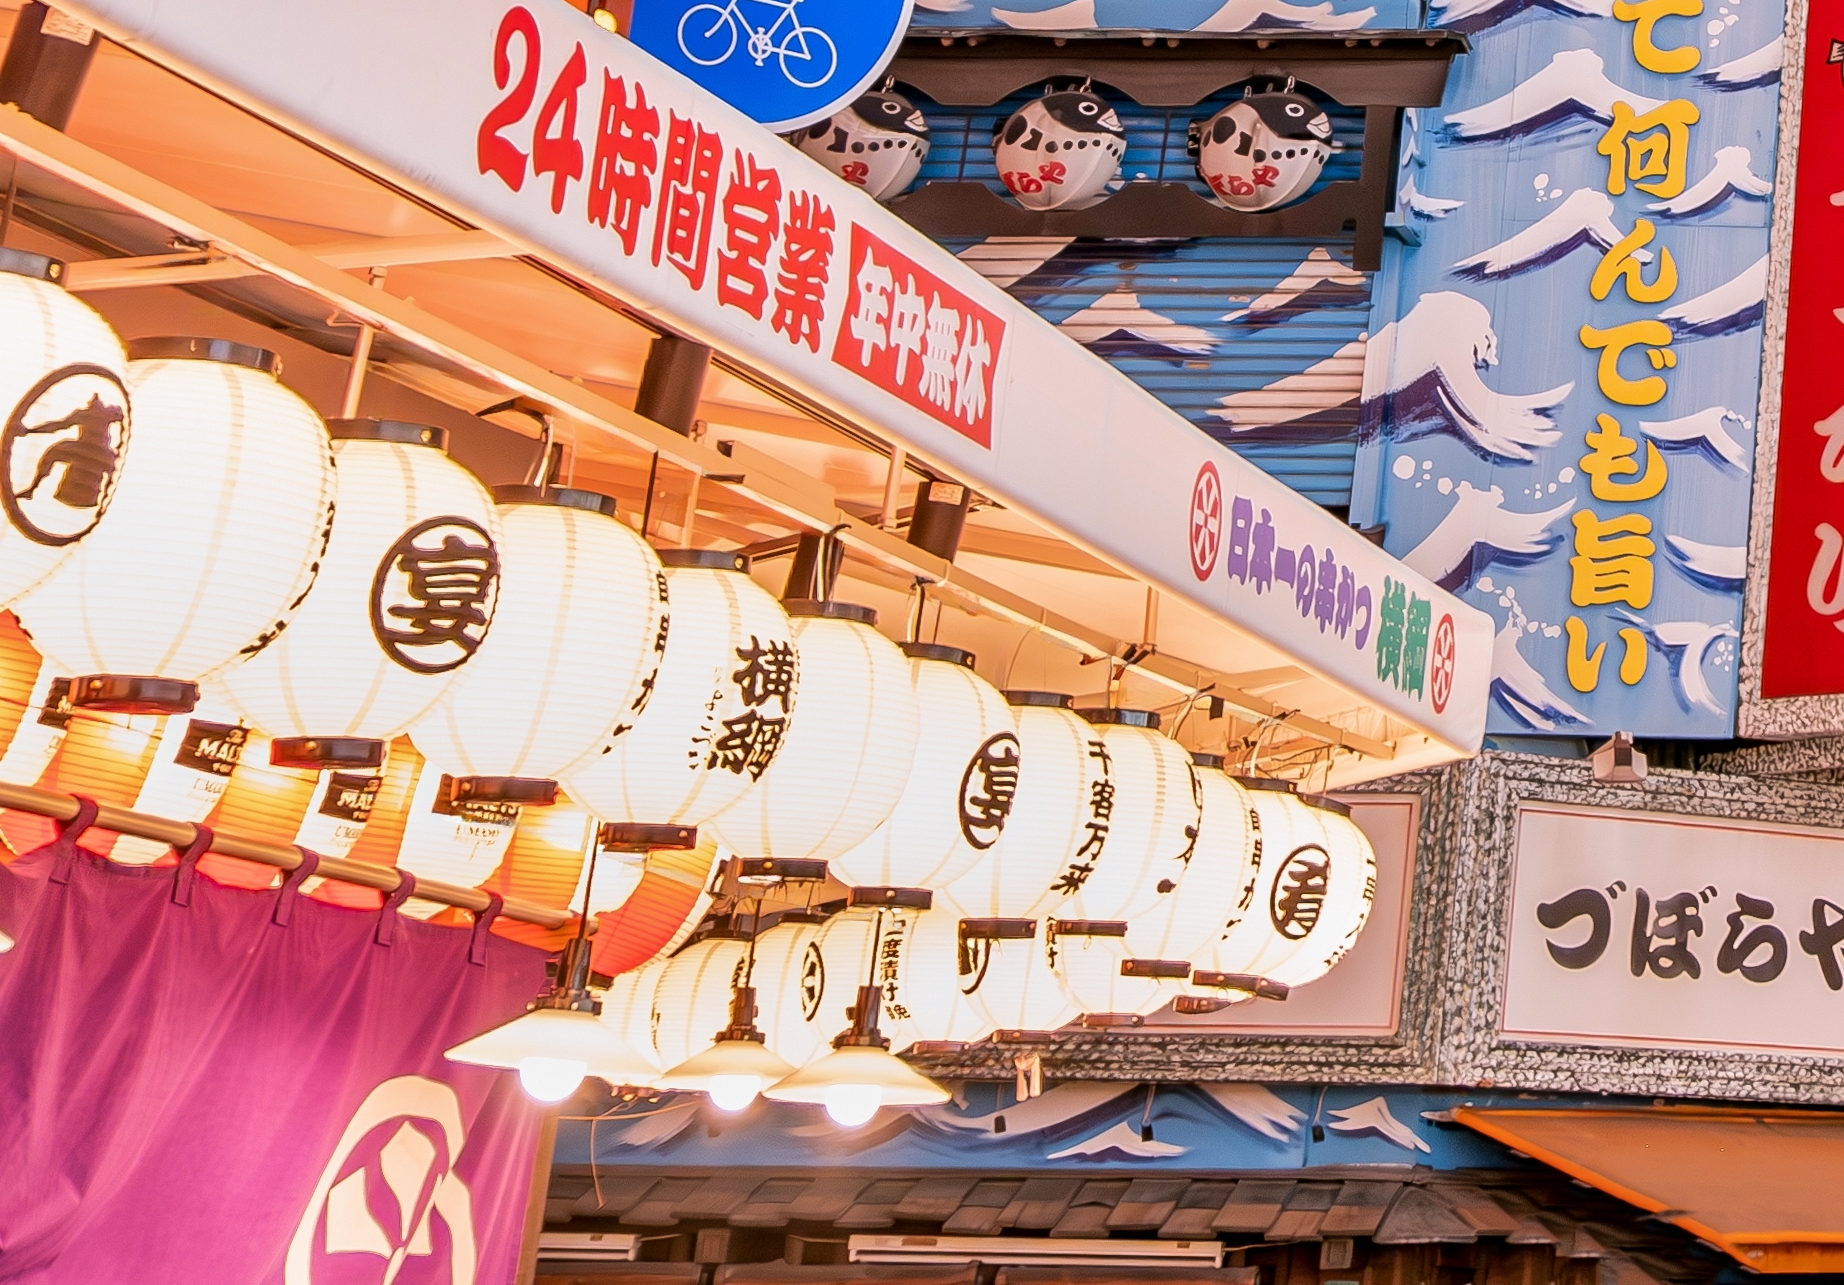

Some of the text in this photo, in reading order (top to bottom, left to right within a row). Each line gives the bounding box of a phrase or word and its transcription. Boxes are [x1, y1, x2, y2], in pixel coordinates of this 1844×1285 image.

[476, 4, 993, 427] 24時間営業 年中無休
[1227, 496, 1432, 702] 日本一の串かつ 横綱
[730, 634, 796, 784] 横綱
[1050, 738, 1117, 898] 千客万来
